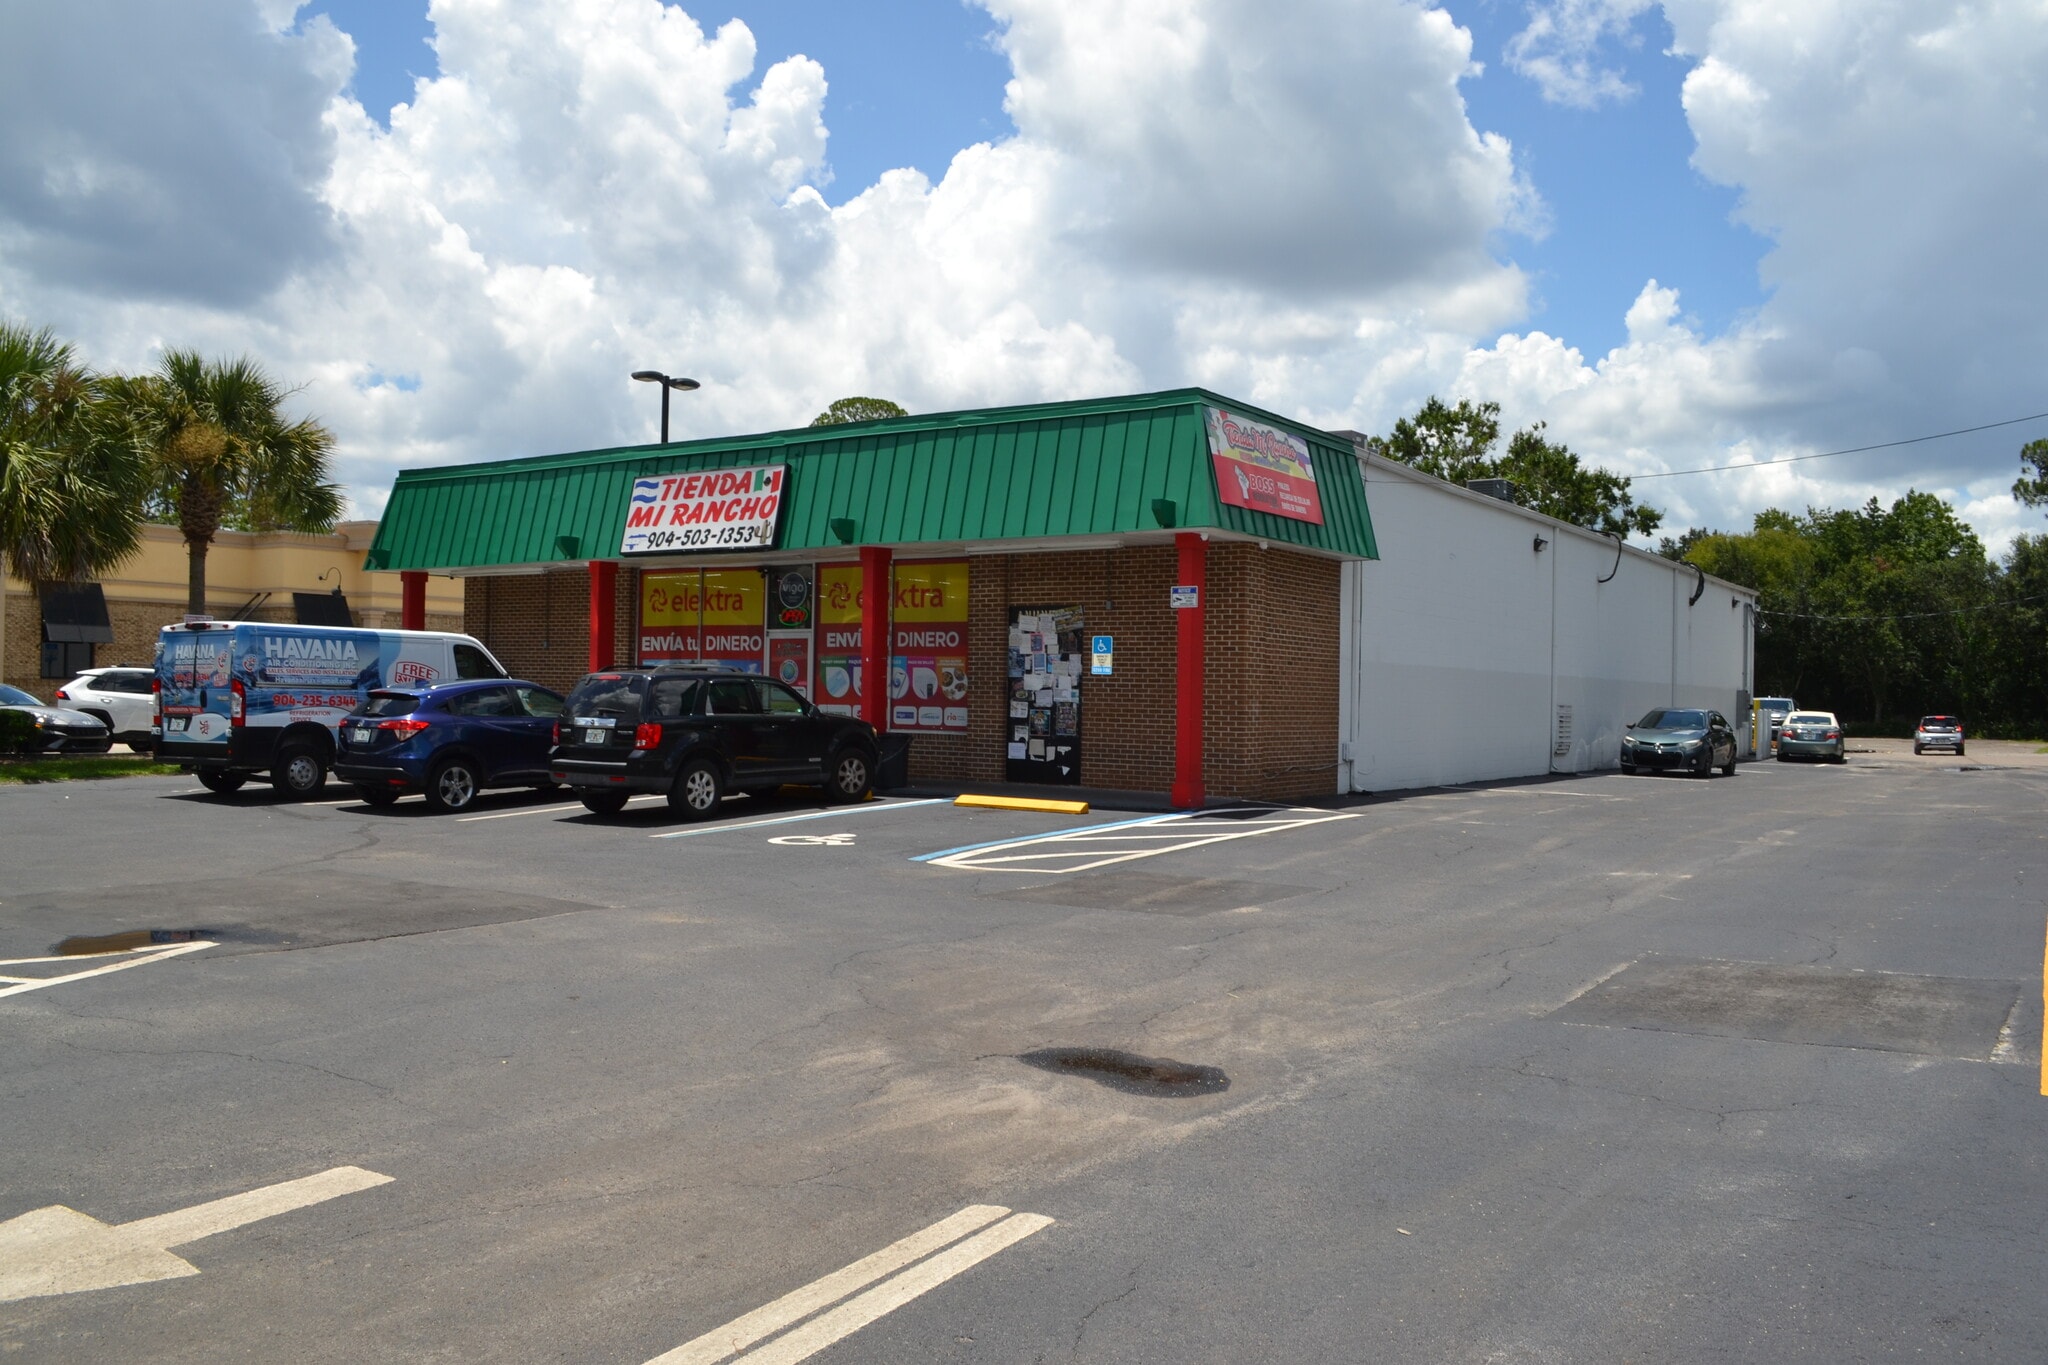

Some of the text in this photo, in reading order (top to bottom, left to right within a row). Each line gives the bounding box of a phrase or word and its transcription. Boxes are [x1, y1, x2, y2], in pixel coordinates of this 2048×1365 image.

[661, 471, 752, 501] TIENDA
[1249, 473, 1275, 494] BOSS
[628, 495, 778, 528] MI RANCHO
[647, 526, 755, 549] 904-503-1353
[782, 584, 804, 594] vigo
[855, 581, 943, 609] ektra
[671, 588, 743, 612] elektra
[642, 632, 684, 652] ENVÍA
[687, 637, 699, 651] tu
[706, 635, 762, 651] DINERO
[827, 628, 959, 648] ENVÍ DINERO
[175, 644, 215, 660] HAVANA
[265, 637, 359, 660] HAVANA
[267, 659, 356, 669] AIR CONDITIONING INC
[402, 663, 433, 680] FREE
[273, 694, 357, 706] 904-235-6344
